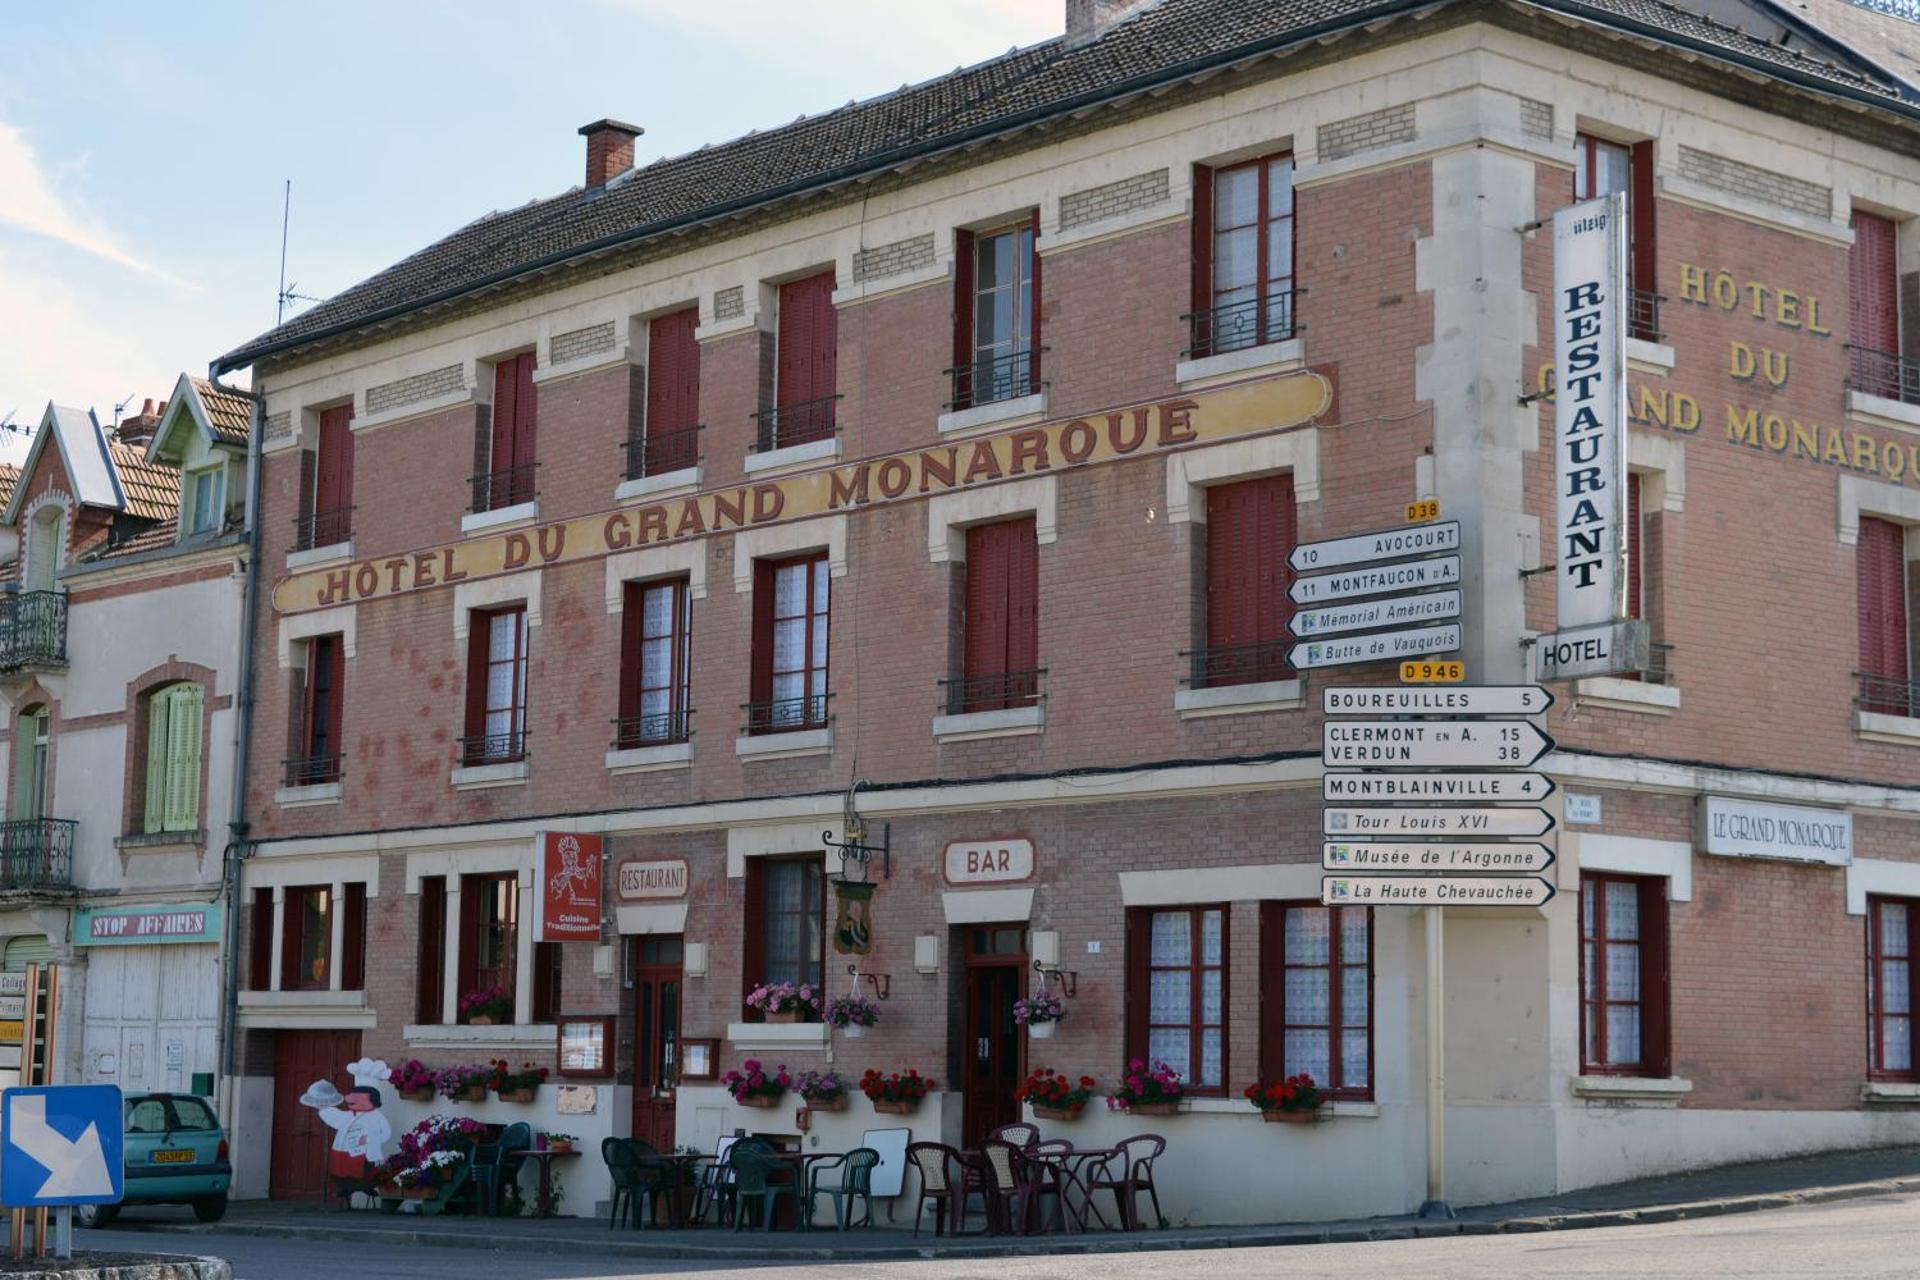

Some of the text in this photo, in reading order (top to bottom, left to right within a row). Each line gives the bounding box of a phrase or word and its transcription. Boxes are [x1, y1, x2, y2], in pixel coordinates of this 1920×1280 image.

[1680, 262, 1831, 337] HÔTEL
[1730, 340, 1790, 388] DU
[1537, 363, 1702, 434] GND
[1564, 280, 1606, 588] RESTAURANT
[317, 399, 1200, 606] HÔTEL DU GRAND MONARQUE
[1303, 529, 1455, 564] 10 AVOCOURT
[1303, 584, 1316, 597] 11
[1331, 567, 1425, 593] MONTFAUCON
[1319, 600, 1455, 628] Mémorial Américain
[1325, 632, 1455, 659] Butte de Vauquois
[1544, 638, 1608, 666] HOTEL
[1330, 693, 1531, 708] BOUREUILLES 5
[1330, 728, 1520, 742] CLERMONT EN A. 15
[1331, 747, 1521, 760] VERDUN 38
[1330, 780, 1532, 794] MONTBLAINVILLE 4
[1355, 815, 1488, 829] Tour Louis XVI
[1713, 813, 1847, 850] LE GRAND MONARQUE
[967, 849, 1011, 874] BAR
[1354, 849, 1534, 867] Musée de l'Argonne
[621, 867, 686, 892] RESTAURANT
[1354, 884, 1534, 898] La Haute Chevauchée
[94, 914, 204, 936] STOP AFFAIRES
[559, 914, 589, 923] Cuisine
